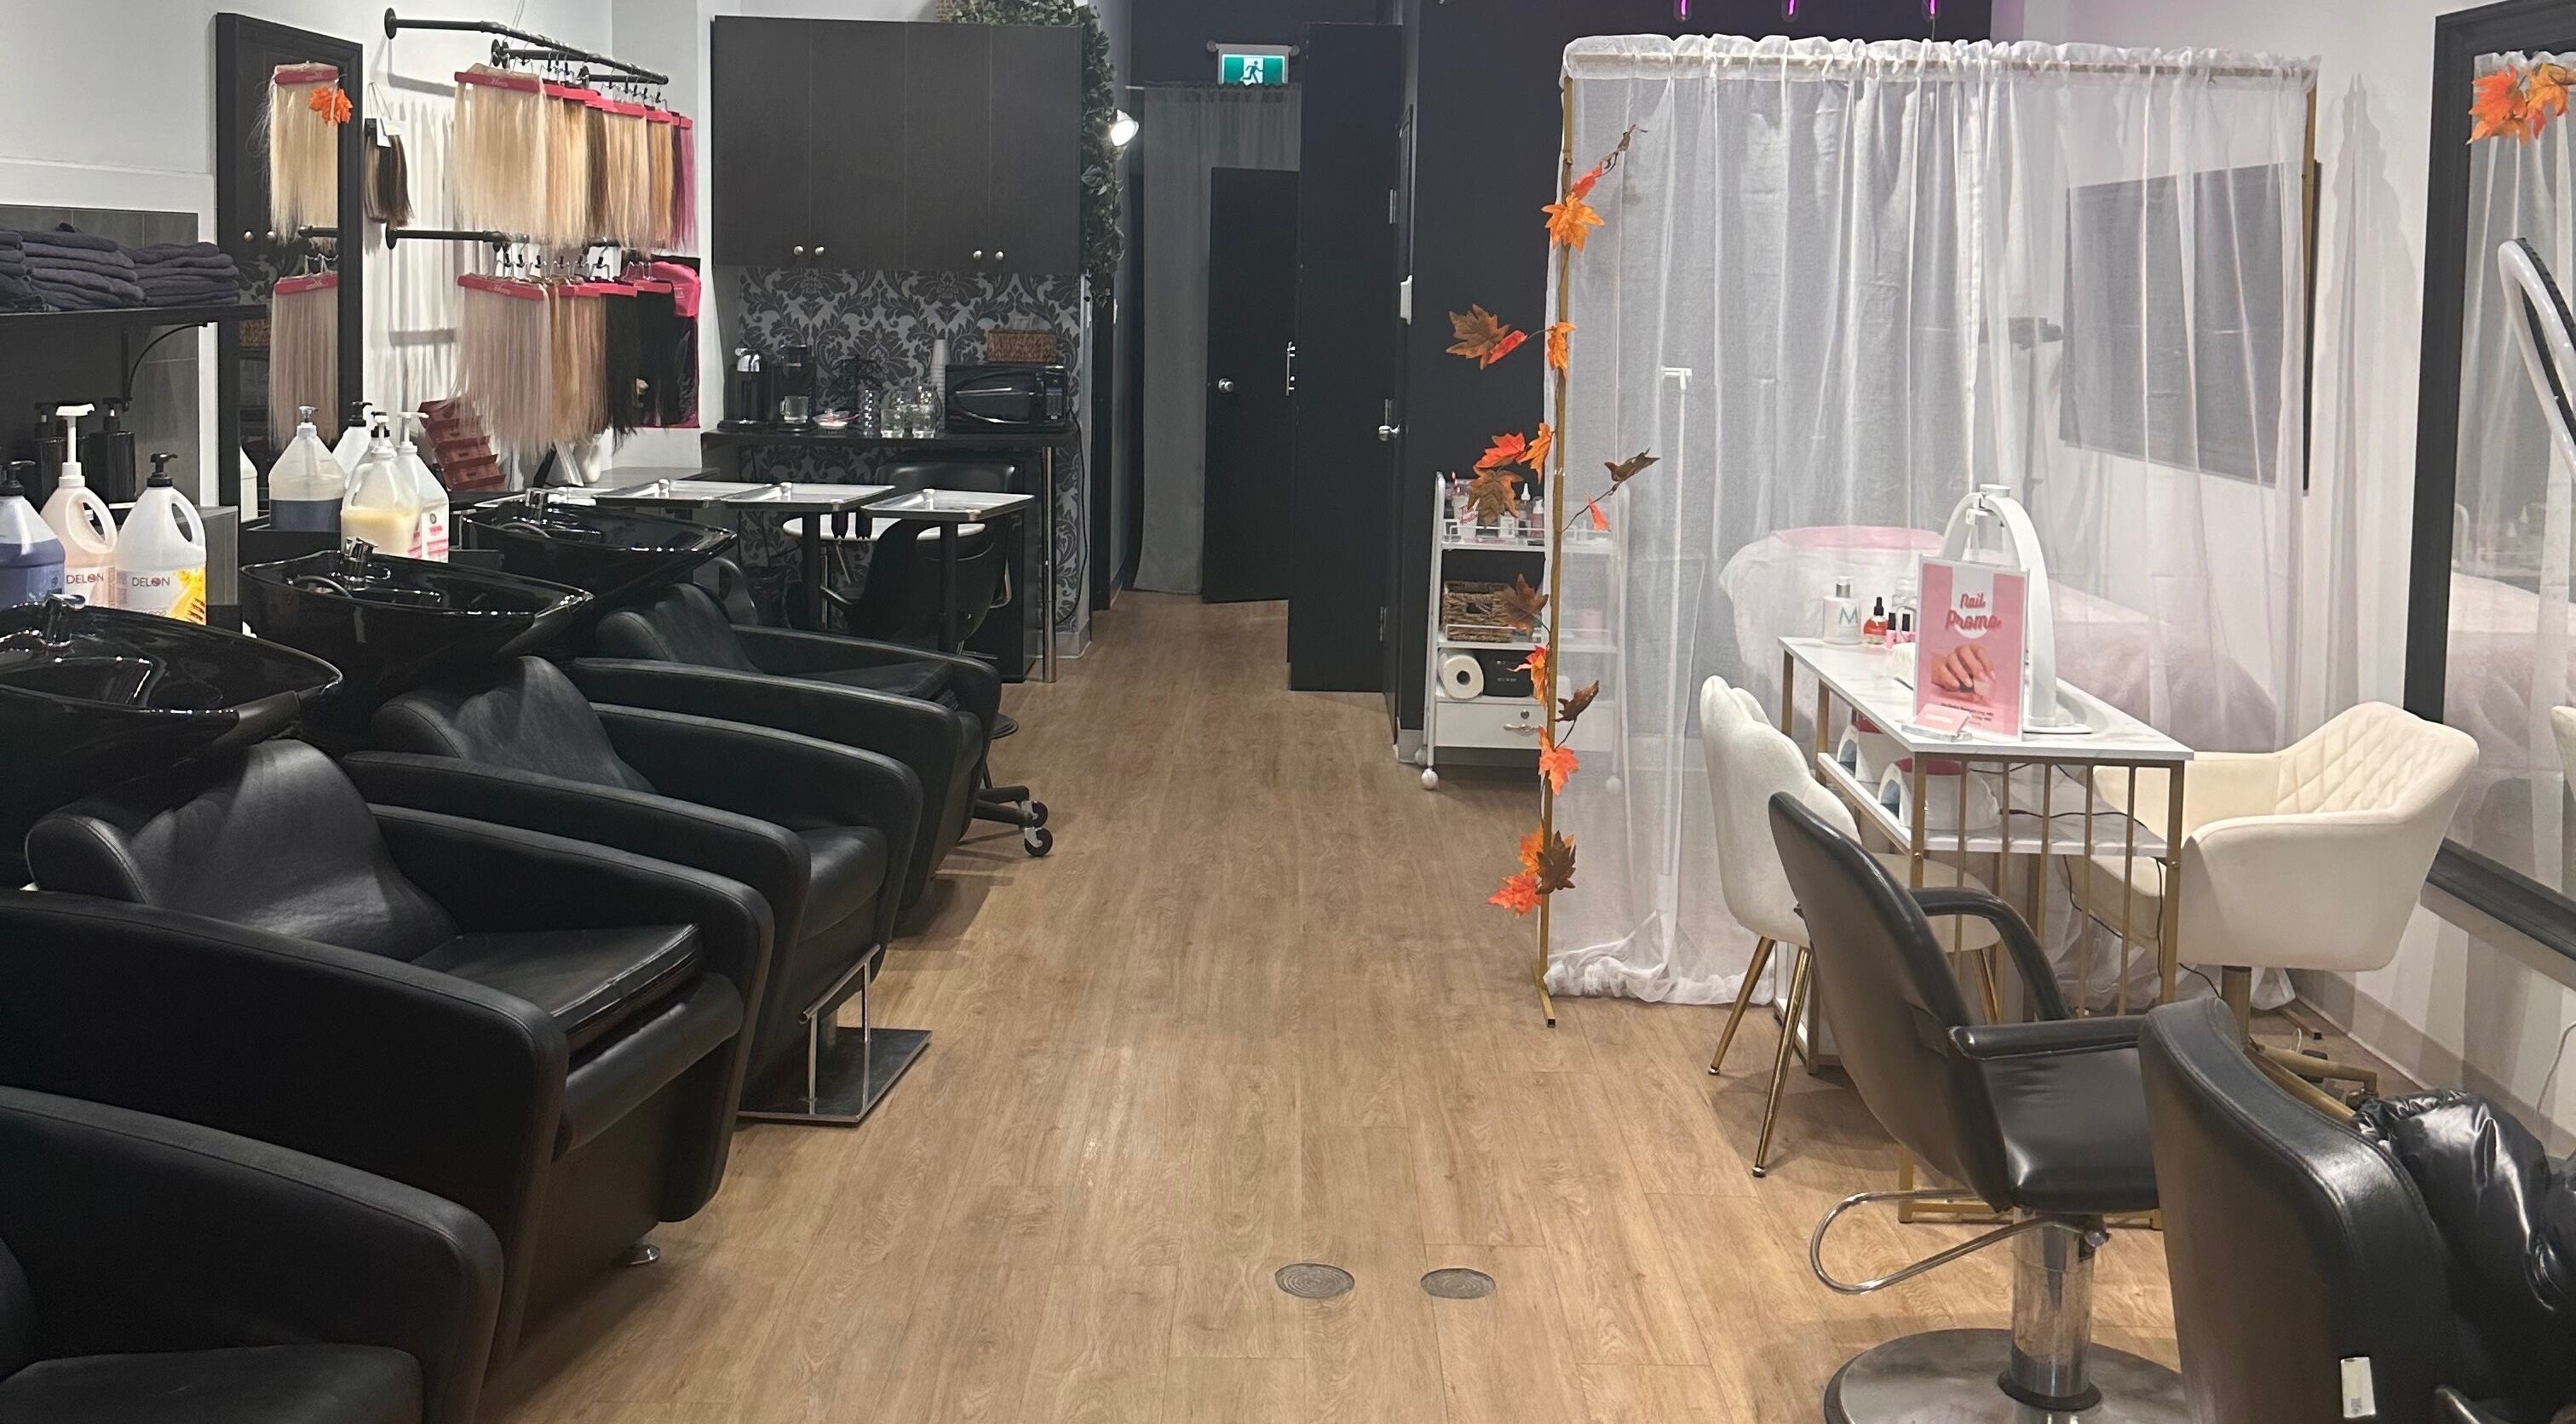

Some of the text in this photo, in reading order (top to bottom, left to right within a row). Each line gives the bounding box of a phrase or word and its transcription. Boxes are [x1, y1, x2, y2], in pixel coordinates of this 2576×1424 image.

[66, 573, 104, 584] DELON
[131, 577, 170, 587] DELON
[1959, 593, 1986, 609] Nail
[1838, 606, 1859, 624] M
[1945, 609, 2002, 630] Promo
